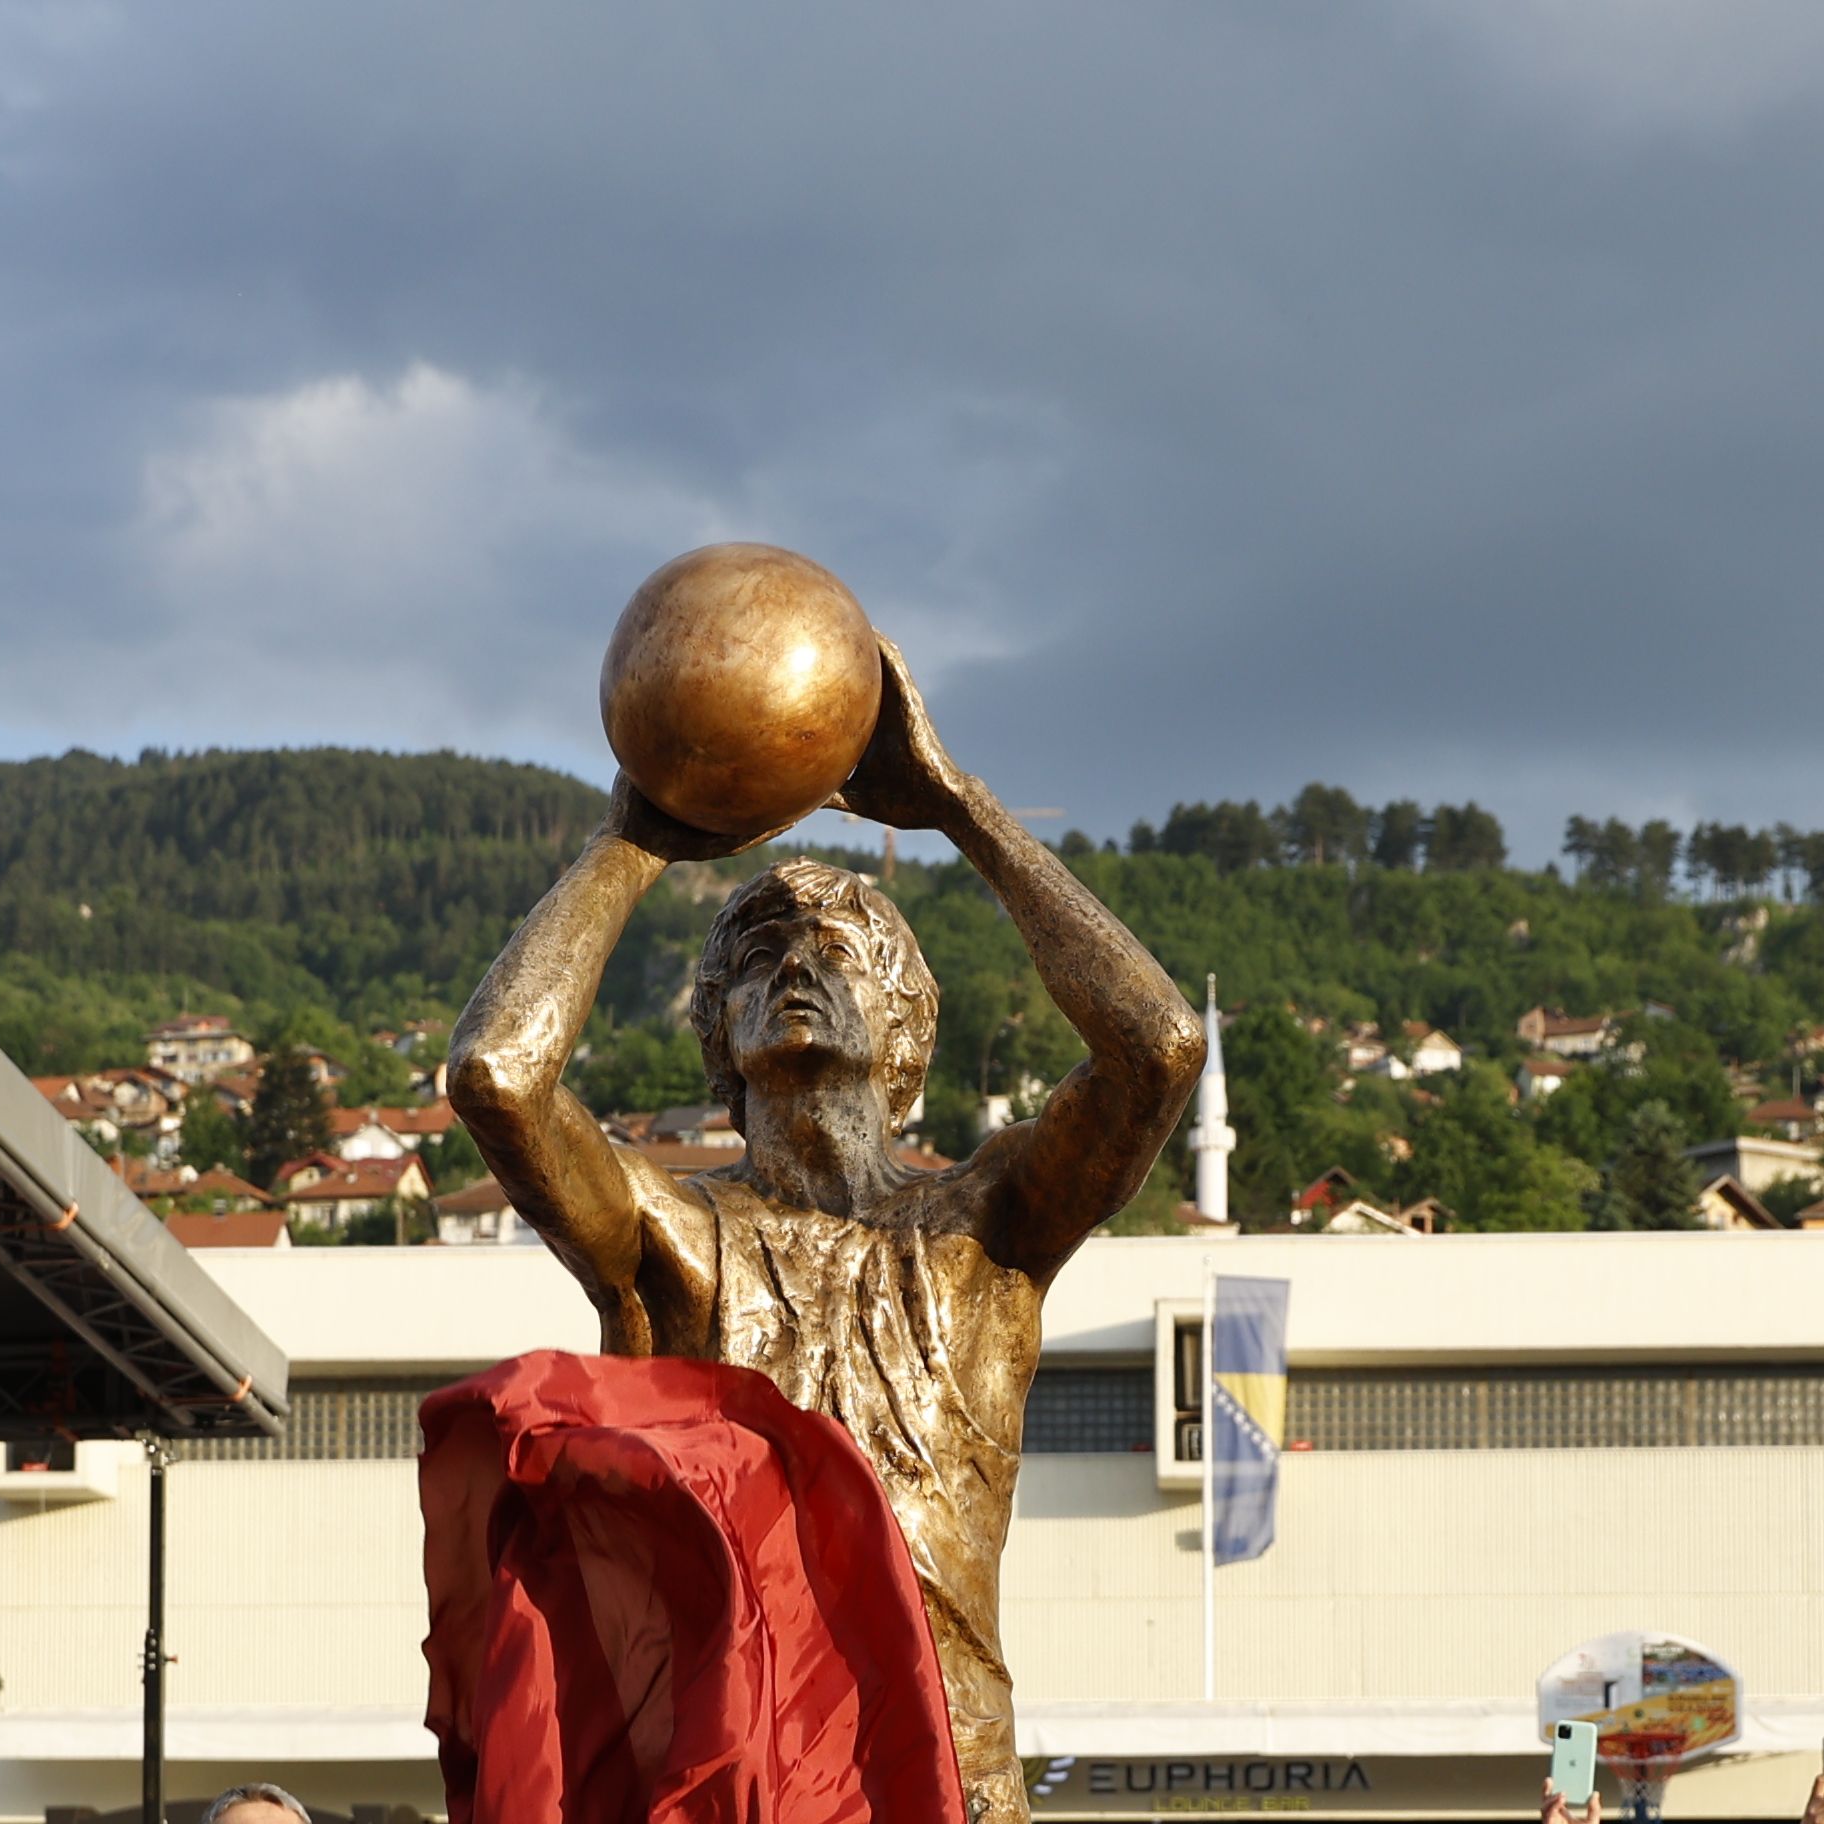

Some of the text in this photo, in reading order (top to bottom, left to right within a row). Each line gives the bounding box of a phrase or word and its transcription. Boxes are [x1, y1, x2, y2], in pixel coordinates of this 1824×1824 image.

[1088, 1761, 1371, 1794] EUPHORIA
[1155, 1796, 1313, 1812] LOUNGE BAR
